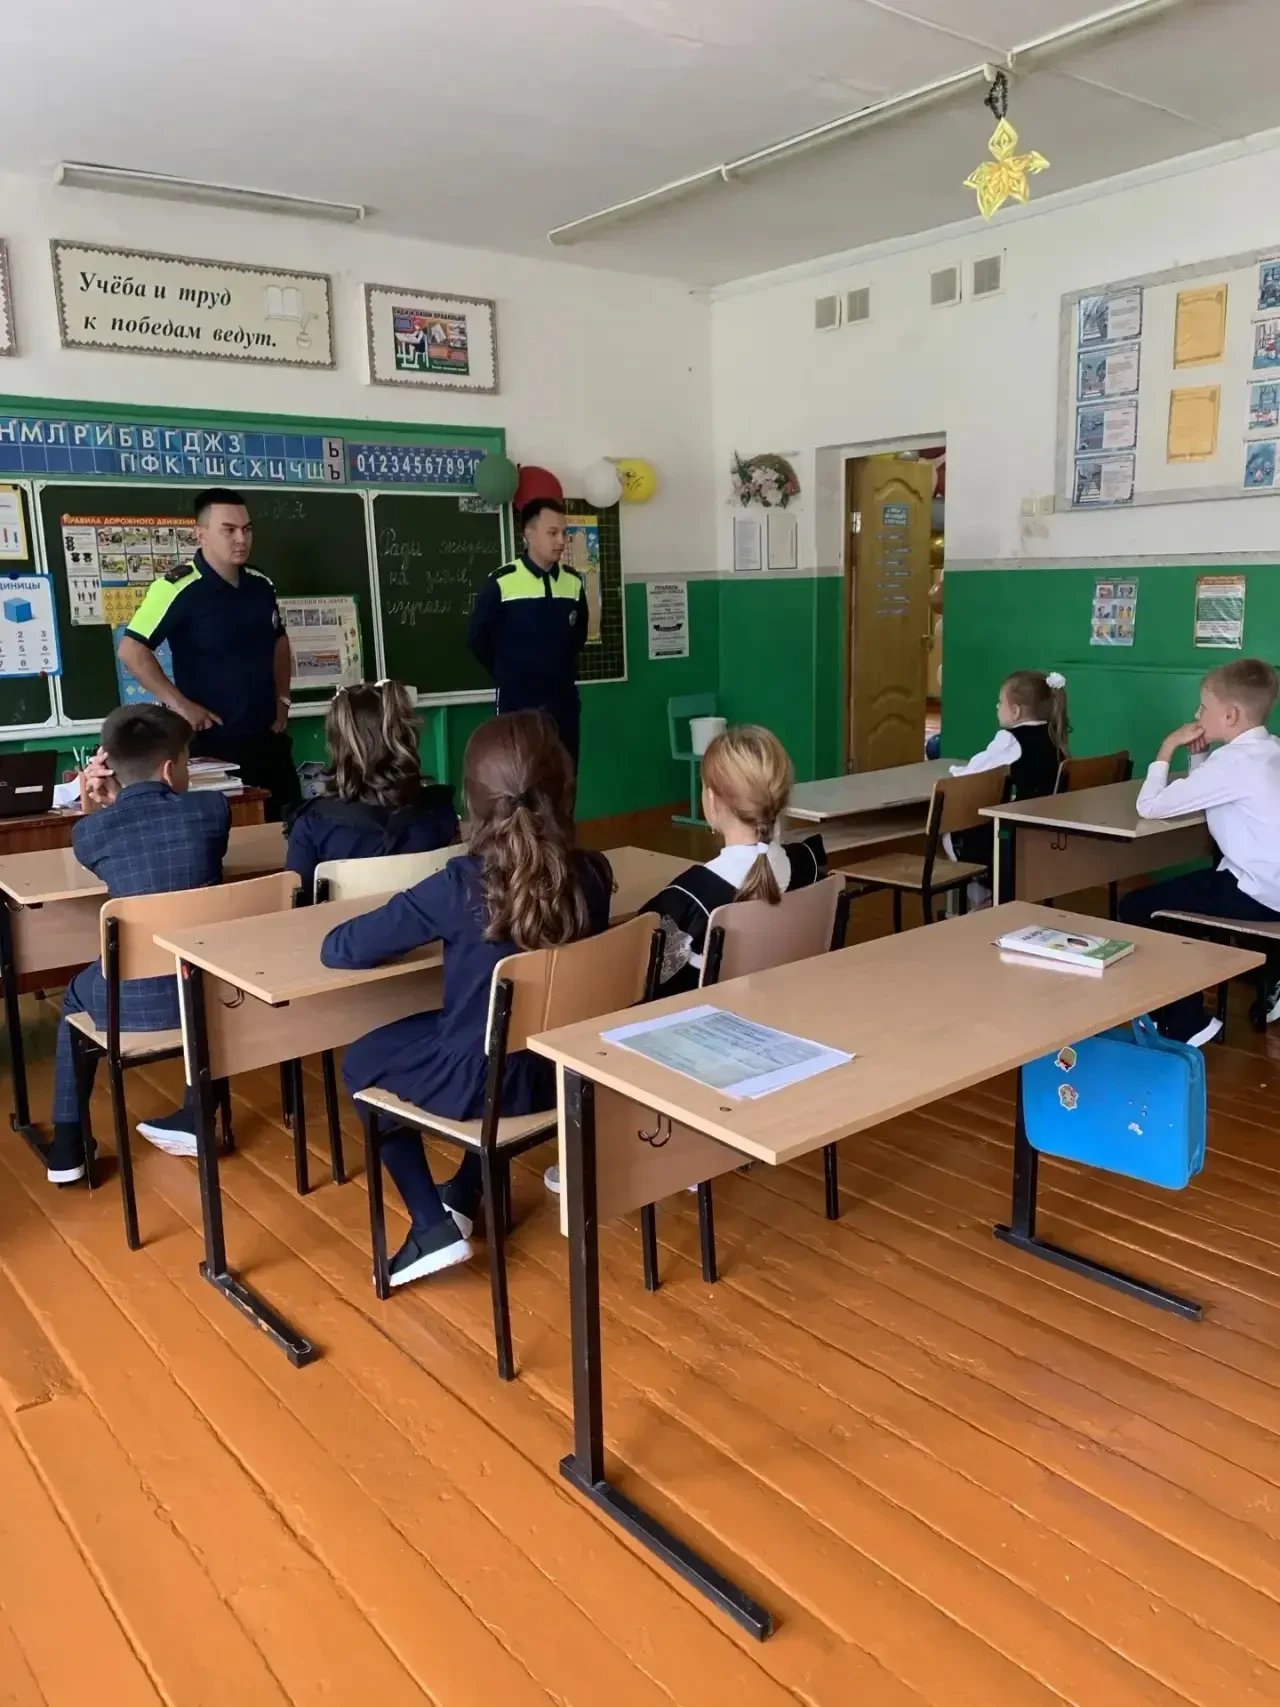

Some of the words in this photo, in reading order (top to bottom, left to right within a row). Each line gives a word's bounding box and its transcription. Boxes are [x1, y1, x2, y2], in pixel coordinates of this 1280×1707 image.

[80, 271, 146, 298] Учёба
[154, 283, 167, 300] и
[178, 286, 232, 310] труд
[83, 315, 97, 330] к
[111, 316, 201, 340] победам
[212, 325, 278, 351] ведут.
